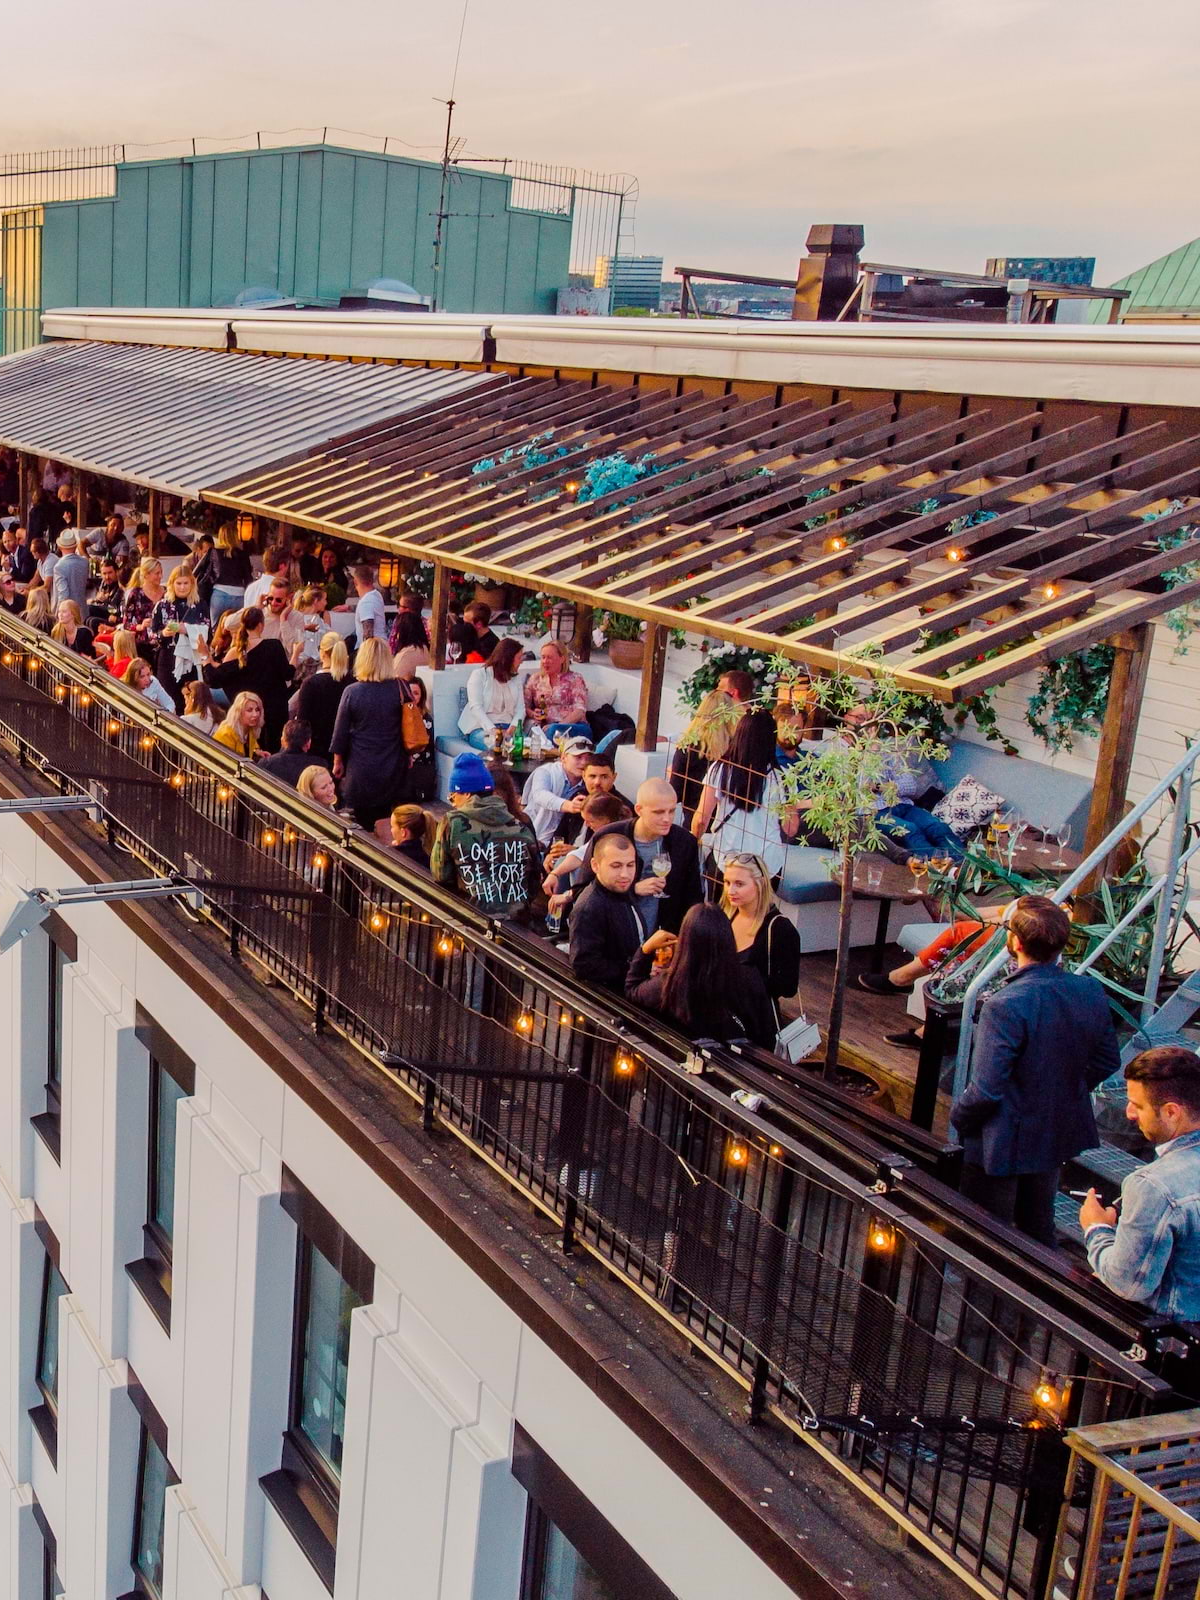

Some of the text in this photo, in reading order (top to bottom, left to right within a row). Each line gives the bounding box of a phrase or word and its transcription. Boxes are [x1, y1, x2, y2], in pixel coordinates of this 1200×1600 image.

[457, 840, 529, 863] LOVE ME
[465, 880, 503, 903] THEY
